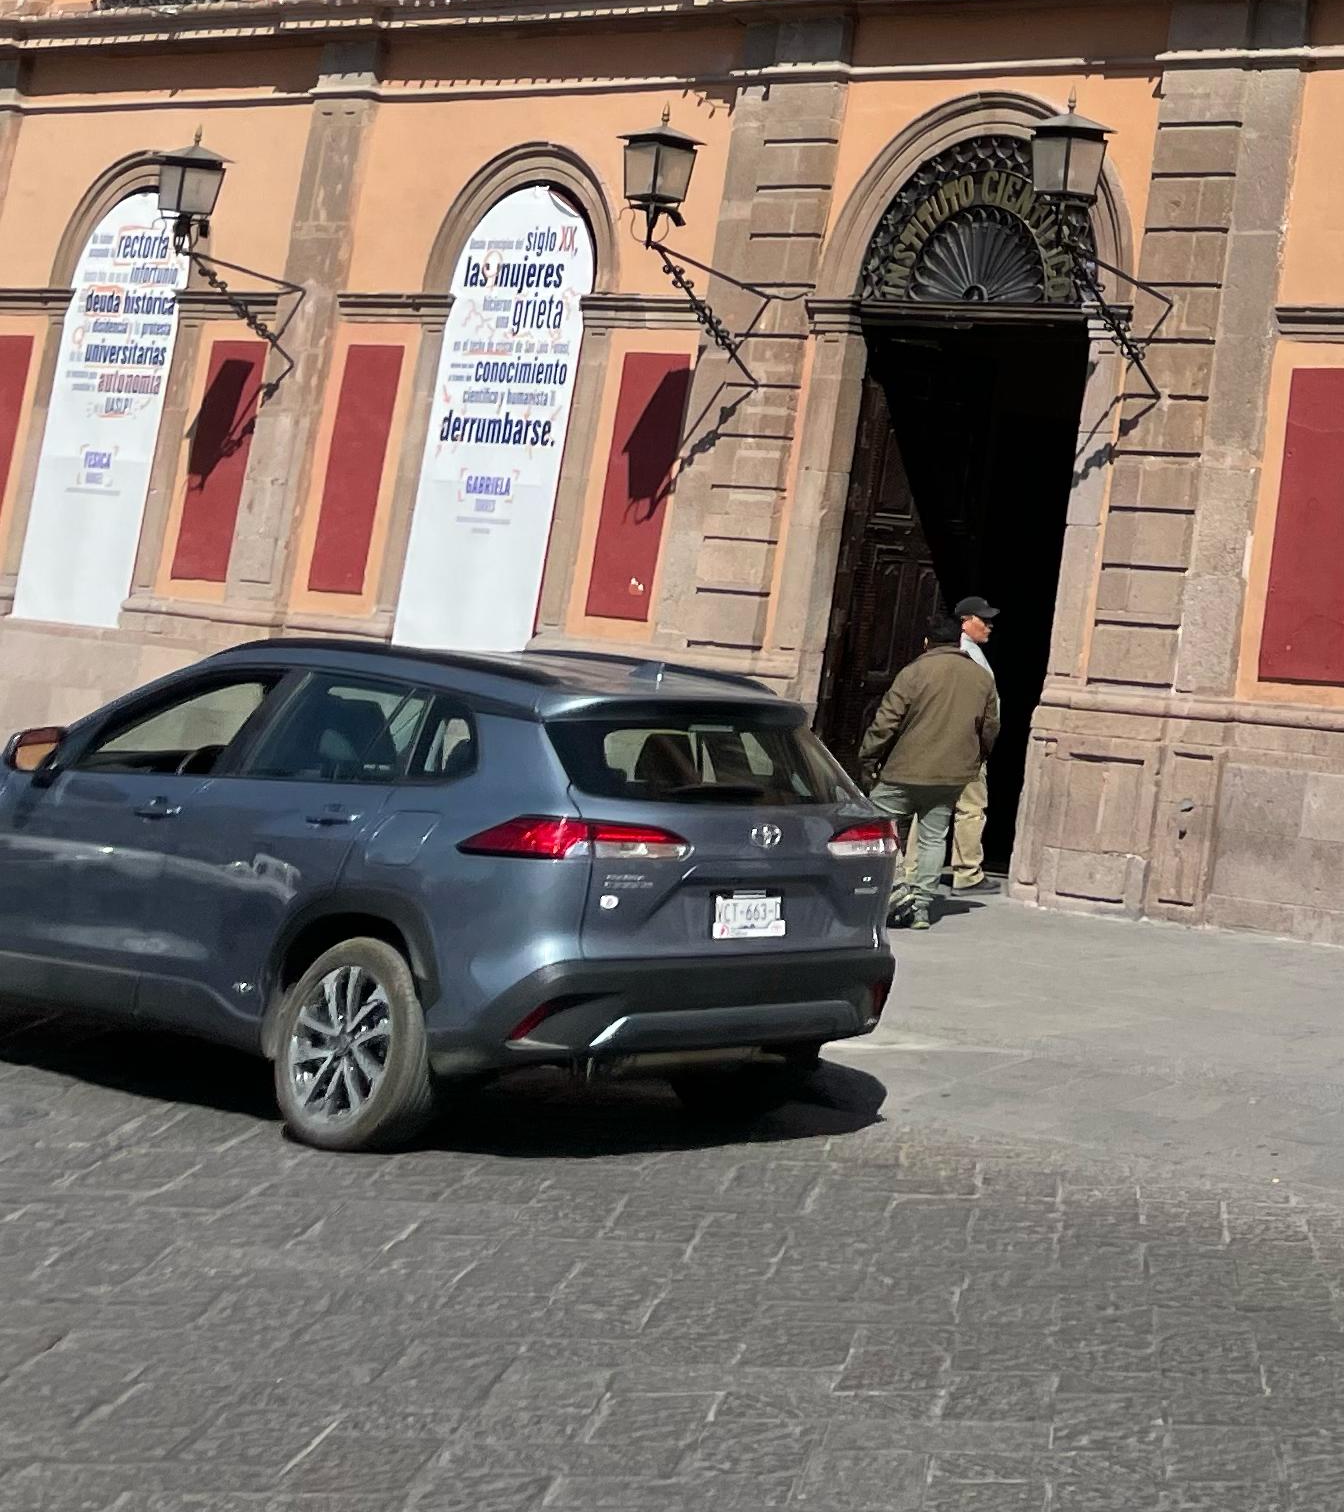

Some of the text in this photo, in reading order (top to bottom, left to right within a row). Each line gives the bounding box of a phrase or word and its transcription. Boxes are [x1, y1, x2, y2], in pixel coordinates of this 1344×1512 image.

[525, 226, 557, 257] siglo
[559, 226, 578, 257] XX,
[880, 174, 975, 297] INSTITUTO
[463, 255, 565, 293] las mujeres
[85, 289, 121, 313] deuda
[512, 292, 564, 336] grieta
[84, 339, 168, 366] universitarias
[475, 356, 568, 385] conocimiento
[440, 409, 555, 447] derrumbarse.
[466, 475, 511, 496] GABRIELA
